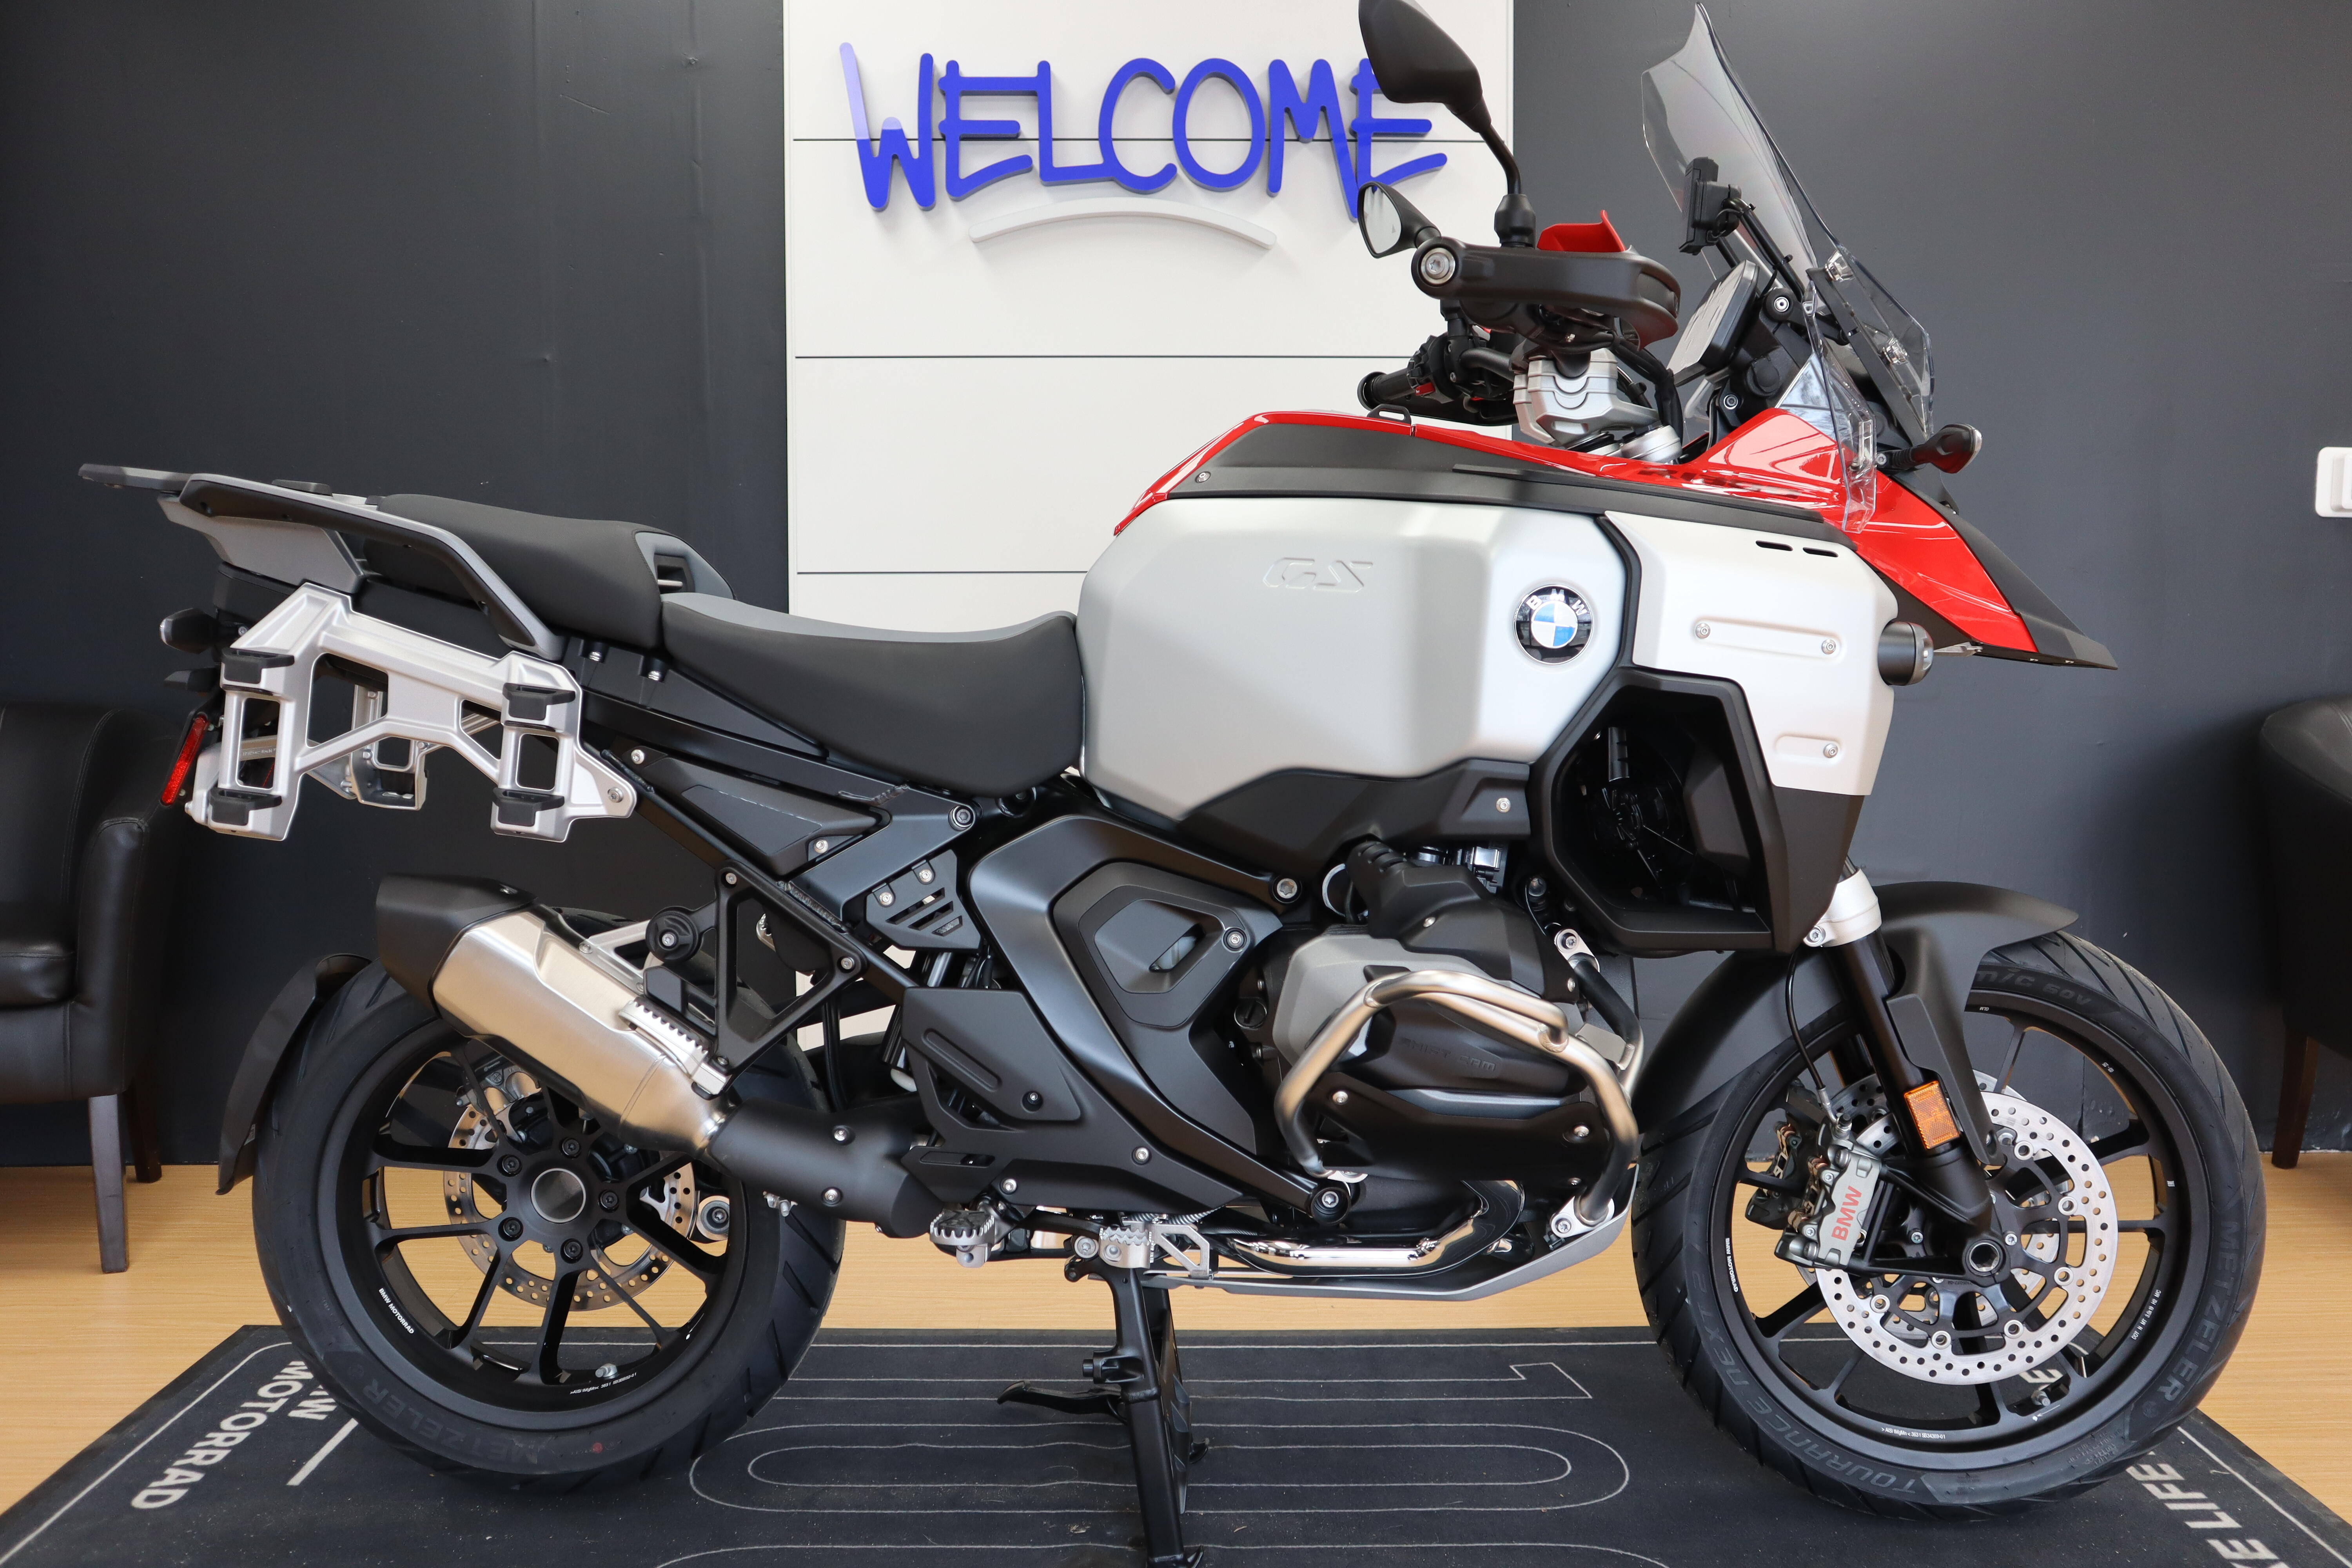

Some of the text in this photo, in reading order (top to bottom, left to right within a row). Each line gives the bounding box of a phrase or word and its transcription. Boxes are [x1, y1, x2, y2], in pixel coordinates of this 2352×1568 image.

[839, 42, 1447, 221] WELCOME
[1262, 557, 1374, 593] GS
[1526, 588, 1587, 615] BMW
[1831, 1185, 1862, 1241] BMW
[1727, 1255, 1739, 1293] MOTORRAD
[379, 1288, 414, 1334] BMW MOTORRAD
[2157, 1220, 2241, 1402] METZELER
[131, 1360, 314, 1509] MOTORRAD
[2125, 1463, 2243, 1529] LIFE
